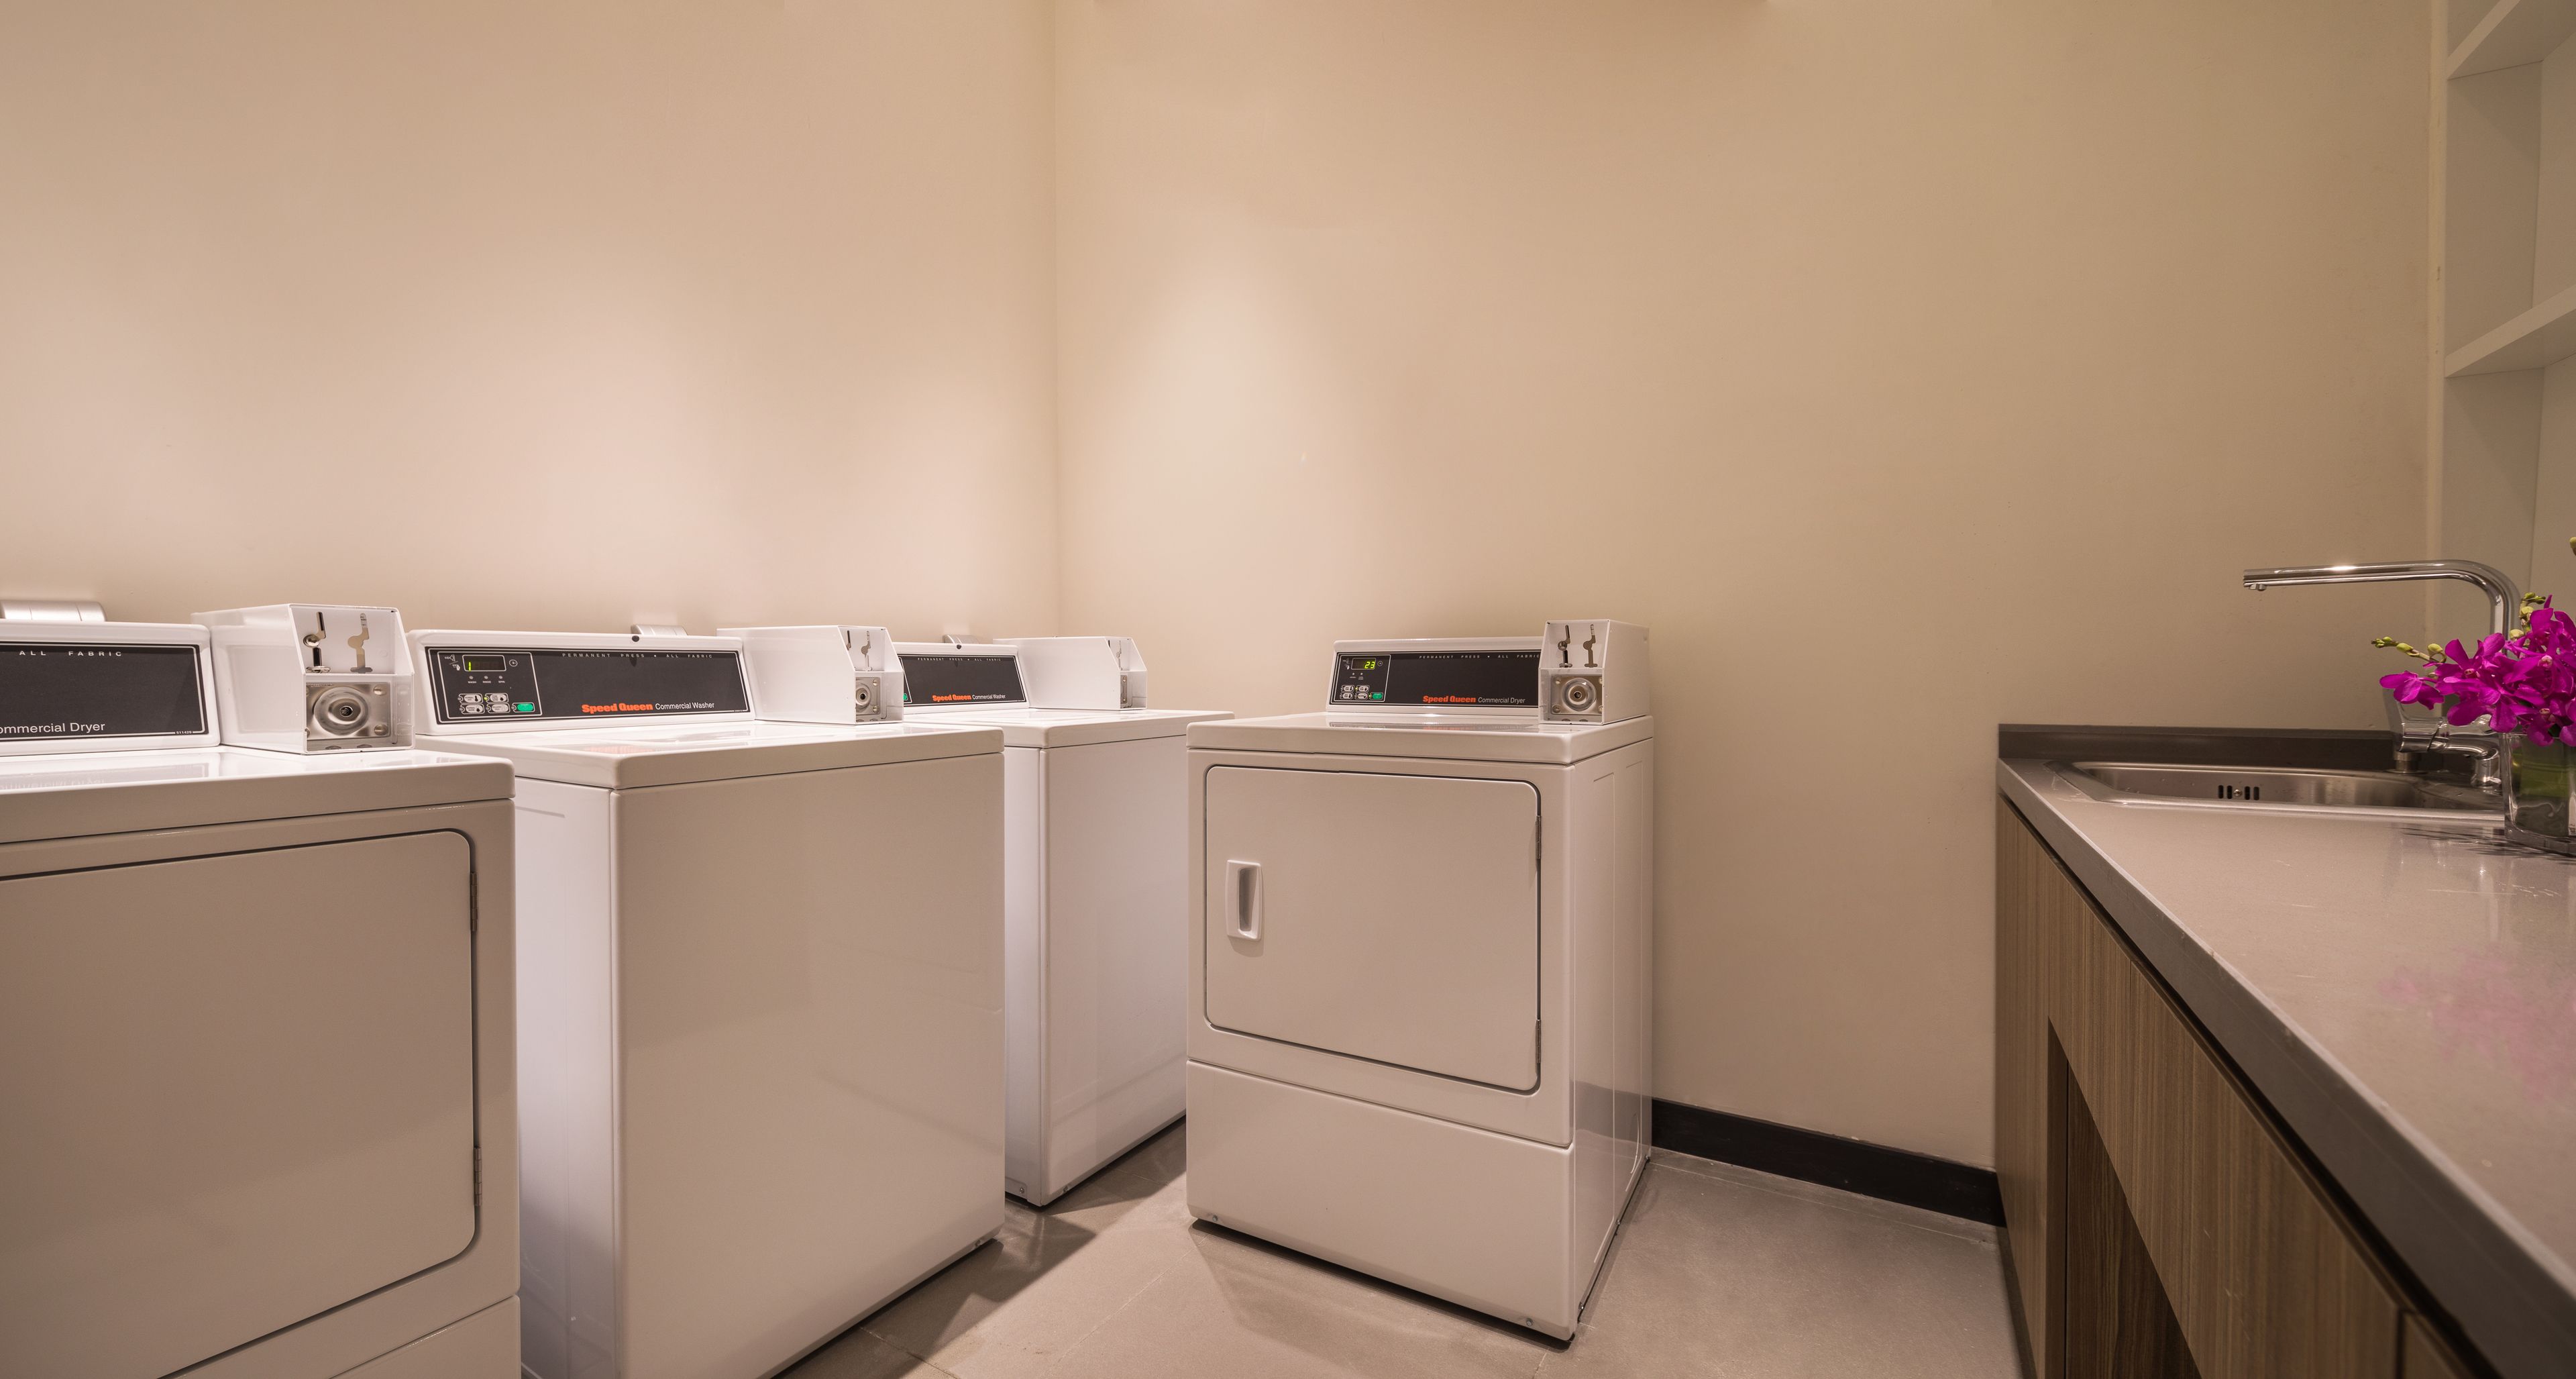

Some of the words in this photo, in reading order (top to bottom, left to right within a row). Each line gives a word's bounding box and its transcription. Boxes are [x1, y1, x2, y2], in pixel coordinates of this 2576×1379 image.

[1364, 661, 1375, 669] 23
[1423, 695, 1449, 704] Speed
[582, 703, 618, 714] Speed
[619, 703, 653, 711] Queen
[655, 702, 692, 711] Commercial
[70, 722, 105, 733] Dryer
